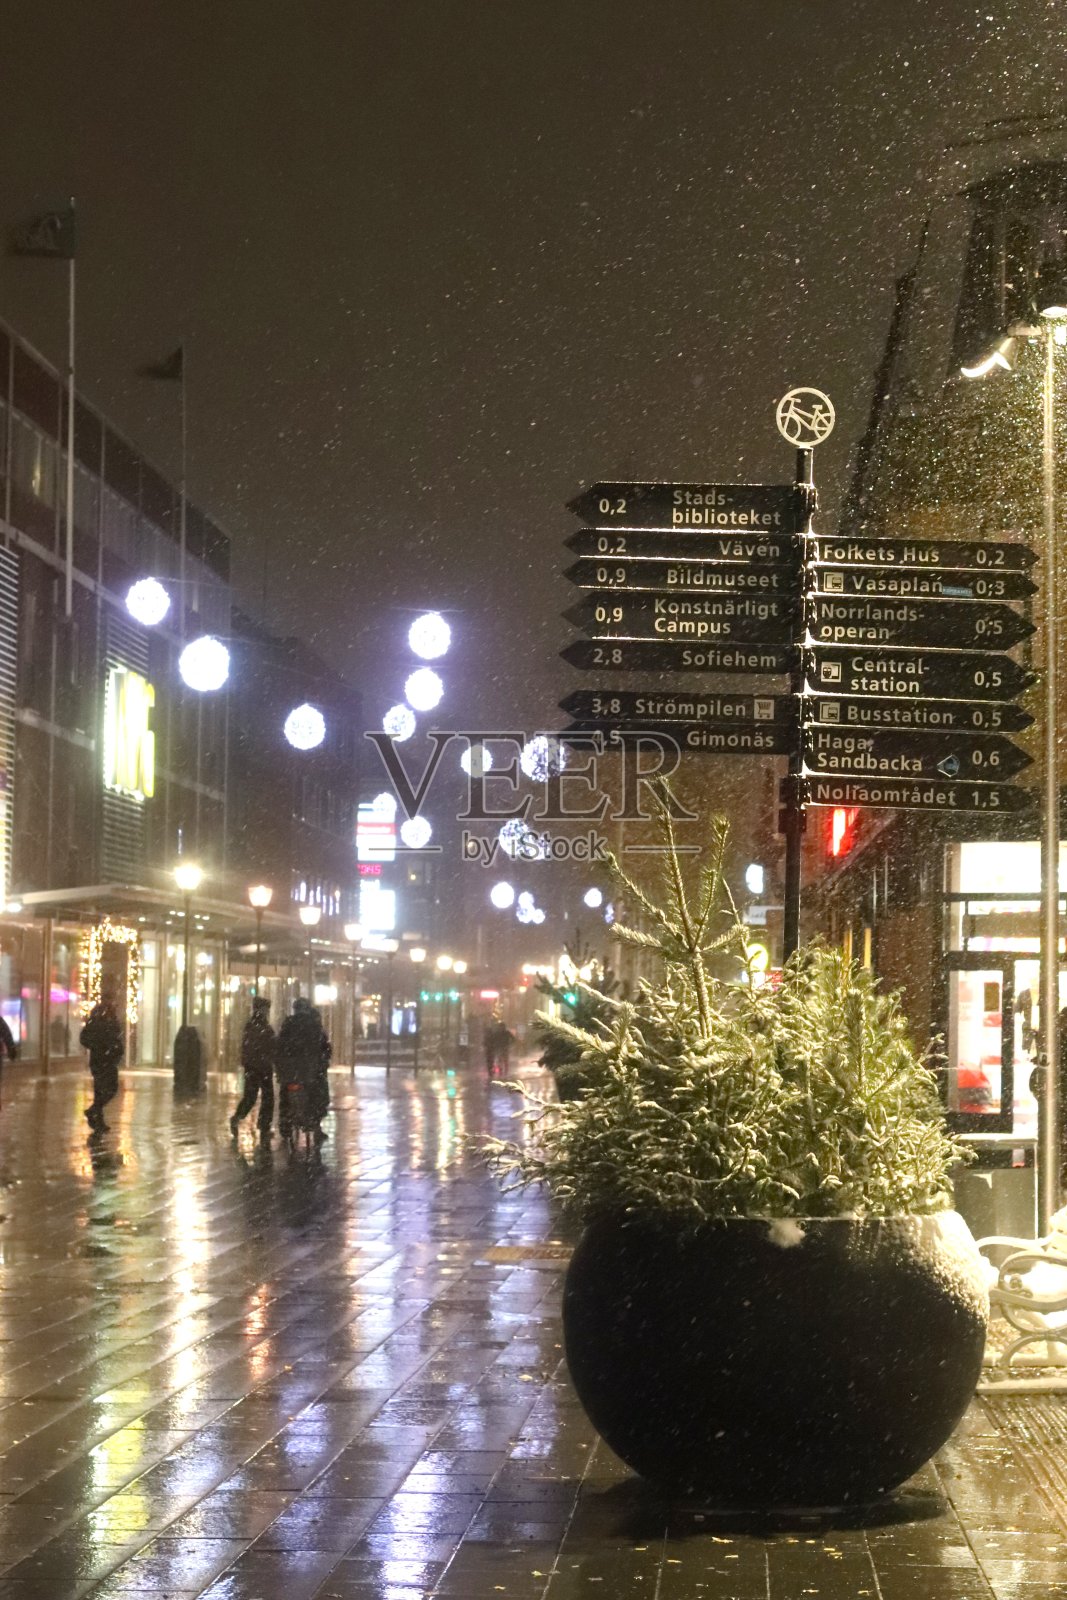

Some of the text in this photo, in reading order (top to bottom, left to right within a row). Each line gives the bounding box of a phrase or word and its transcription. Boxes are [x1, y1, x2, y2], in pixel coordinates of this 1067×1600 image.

[673, 490, 734, 506] Stads-
[599, 499, 627, 516] 0,2
[672, 508, 782, 526] biblioteket
[597, 537, 780, 557] 0,2 Väven
[823, 544, 1005, 567] Folkets Hus 0,2
[596, 568, 779, 588] 0,9 Bildmuseet
[852, 575, 943, 594] Vasaplan
[595, 607, 623, 624] 0,9
[654, 599, 779, 620] Konstnärligt
[821, 603, 925, 622] Norrlands-
[654, 618, 731, 637] Campus
[820, 625, 890, 643] operan
[975, 619, 1003, 637] 0,5
[593, 648, 777, 667] 2,8 Sofiehem
[851, 657, 930, 675] Central-
[850, 677, 920, 693] station
[974, 671, 1002, 688] 0,5
[591, 698, 746, 719] 3,8 Strömpilen
[847, 706, 1001, 728] Busstation 0,5
[687, 731, 775, 748] Gimonäs
[817, 753, 923, 771] Sandbacka
[972, 750, 1000, 767] 0,6
[817, 784, 1000, 808] Noliaområdet 1,5
